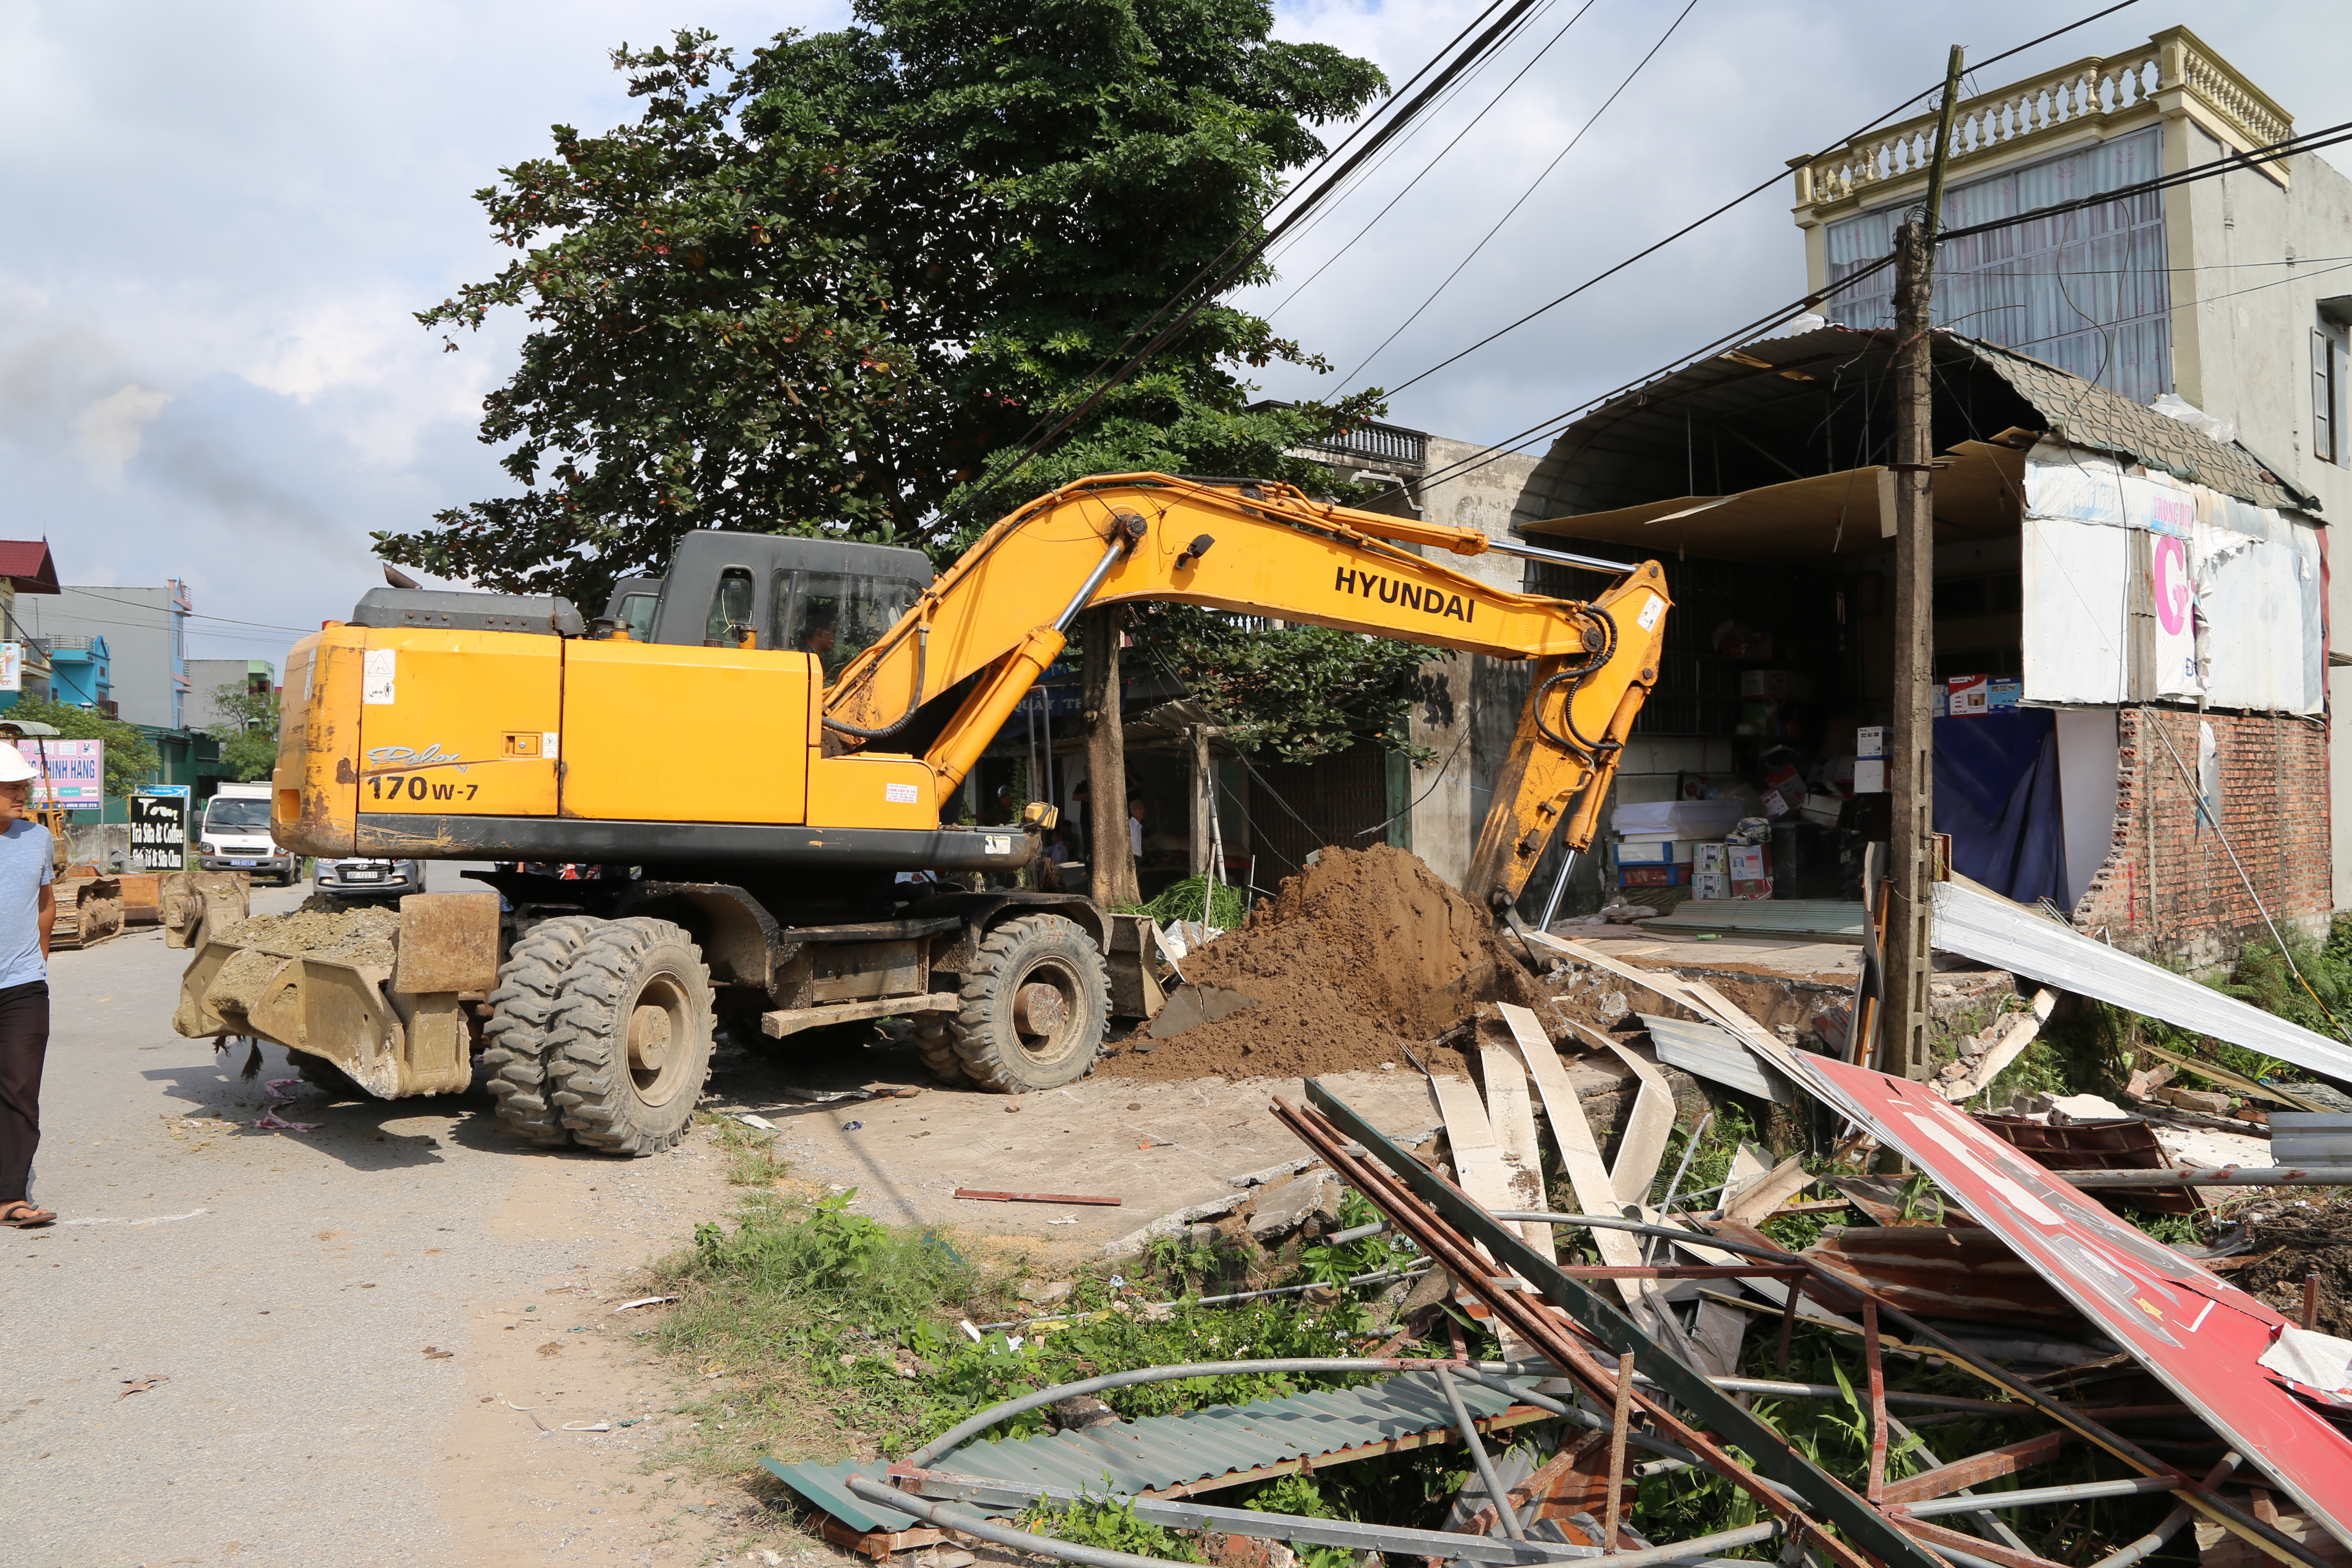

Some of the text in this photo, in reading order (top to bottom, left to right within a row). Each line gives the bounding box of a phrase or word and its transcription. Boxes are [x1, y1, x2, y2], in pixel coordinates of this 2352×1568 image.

[2153, 495, 2179, 527] TRỌNG
[1335, 566, 1475, 623] HYUNDAI
[40, 756, 68, 779] CHÍNH
[70, 756, 95, 779] HÃNG
[132, 822, 142, 843] Trà
[156, 823, 163, 843] &
[163, 823, 183, 843] Coffee
[152, 848, 157, 867] &
[168, 849, 181, 867] Chua
